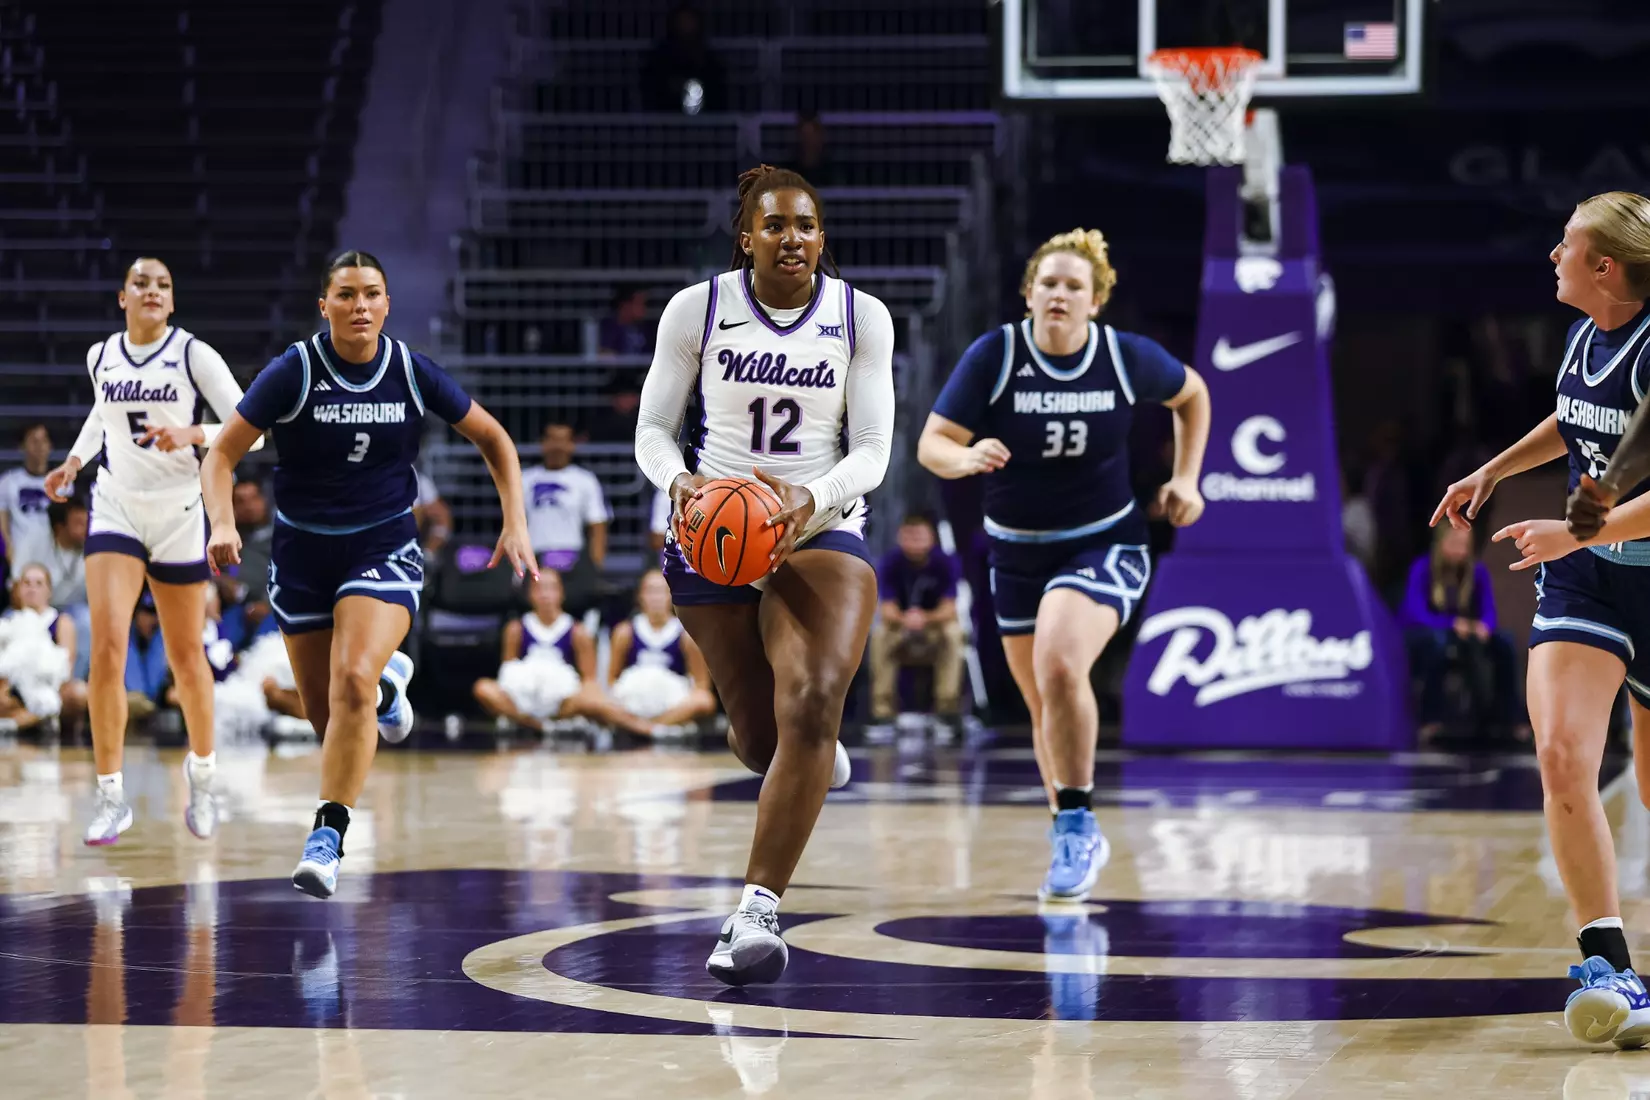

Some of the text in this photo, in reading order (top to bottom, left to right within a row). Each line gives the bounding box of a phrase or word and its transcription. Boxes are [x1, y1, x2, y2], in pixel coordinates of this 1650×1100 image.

[718, 348, 836, 388] Wildcats
[102, 380, 178, 402] Wildcats
[1013, 390, 1115, 414] WASHBURN
[313, 402, 406, 423] WASHBURN
[748, 396, 803, 455] 12
[347, 432, 371, 463] 3
[1041, 420, 1088, 458] 33
[1202, 473, 1315, 501] Channel
[683, 507, 705, 564] ELITE
